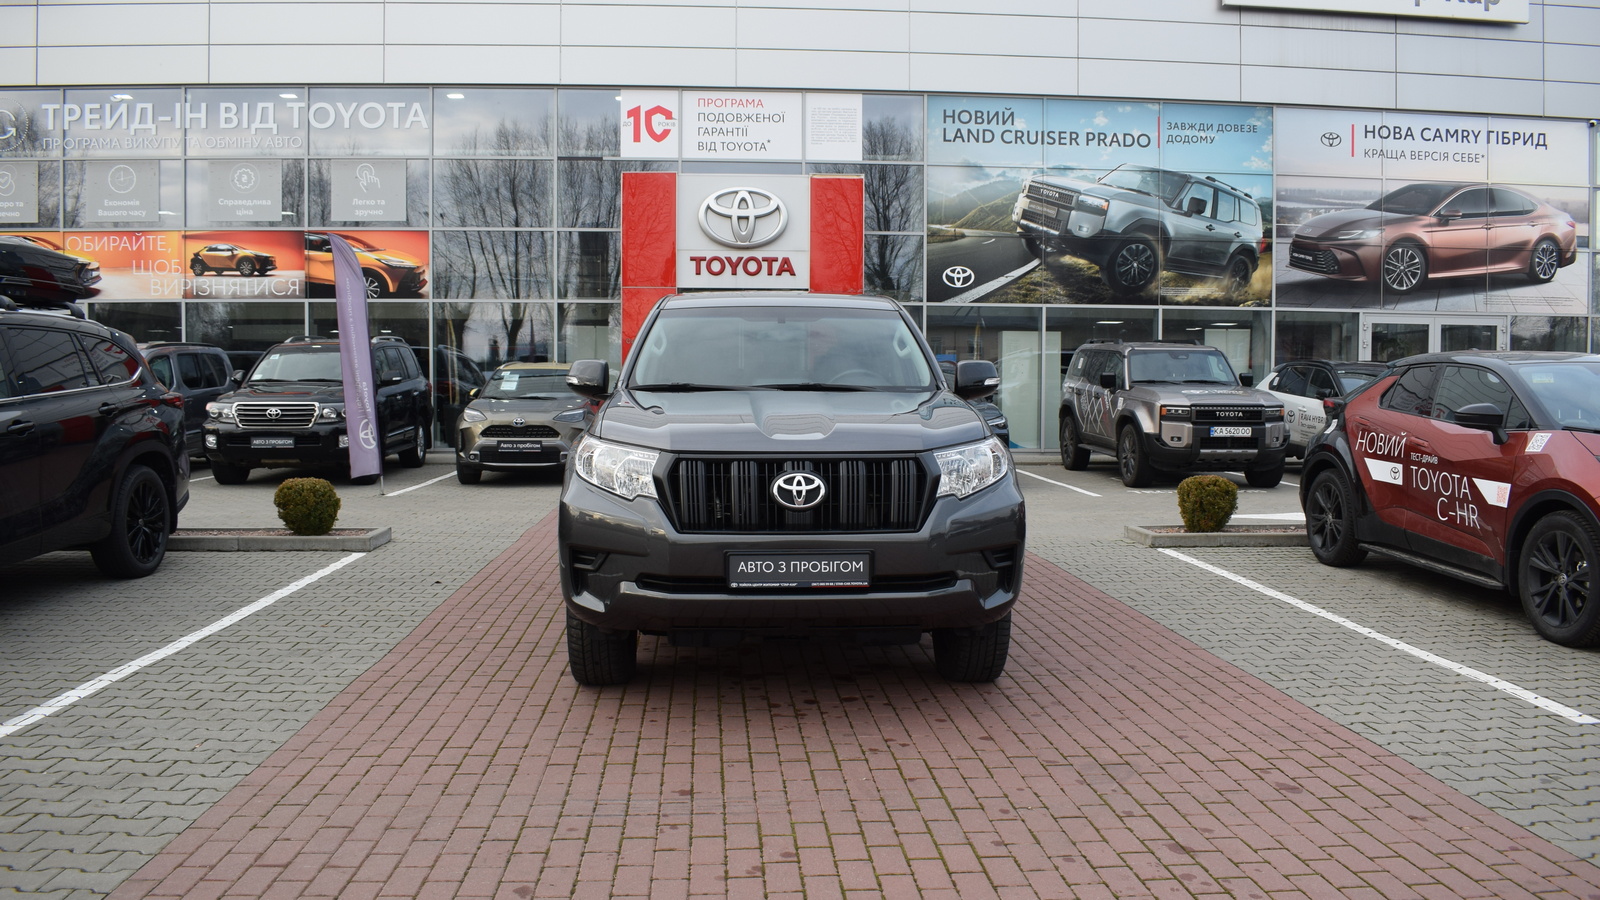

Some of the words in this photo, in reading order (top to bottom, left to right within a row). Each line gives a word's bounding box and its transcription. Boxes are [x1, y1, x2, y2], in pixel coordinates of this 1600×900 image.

[697, 98, 764, 108] ПРОГРАМА
[41, 95, 207, 136] ТРЕЙД-ІН
[219, 102, 278, 135] ВІД
[286, 102, 429, 129] TOYOTA
[697, 112, 786, 124] ПОДОВЖЕНОЇ
[942, 107, 1015, 126] НОВИЙ
[697, 125, 748, 137] ГАРАНТІЇ
[1166, 121, 1214, 133] ЗАВЖДИ
[1216, 122, 1258, 135] ДОВЕЗЕ
[43, 137, 121, 150] ПРОГРАМА
[125, 137, 181, 149] ВИКУПУ
[185, 137, 201, 149] ТА
[205, 136, 262, 149] ОБМІНУ
[265, 136, 302, 149] АВТО
[942, 128, 996, 144] LAND
[1000, 129, 1080, 146] CRUISER
[1085, 131, 1152, 149] PRADO
[1166, 134, 1216, 145] ДОДОМУ
[1364, 124, 1415, 141] НОВА
[1420, 127, 1482, 145] CAMRY
[1487, 130, 1548, 150] ГІБРИД
[697, 141, 717, 152] ВІД
[1363, 148, 1406, 161] КРАЩА
[1410, 151, 1449, 162] ВЕРСІЯ
[1040, 188, 1059, 198] TOYOTA
[218, 199, 272, 208] Справедлива
[97, 209, 127, 217] Вашого
[129, 210, 146, 218] часу
[236, 208, 254, 217] ціна
[354, 209, 383, 217] зручно
[66, 232, 172, 254] ОБИРАЙТЕ,
[132, 259, 182, 278] ЩОБ
[690, 256, 796, 276] TOYOTA
[151, 278, 300, 297] ВИРІЗНЯТИСЯ
[1355, 431, 1407, 458] НОВИЙ
[1410, 452, 1438, 465] ТЕСТ-ДРАЙВ
[1410, 465, 1472, 501] TOYOTA
[1437, 497, 1480, 529] C-HR
[738, 561, 774, 573] АВТО
[778, 561, 786, 573] З
[790, 561, 864, 573] ПРОБІГОМ
